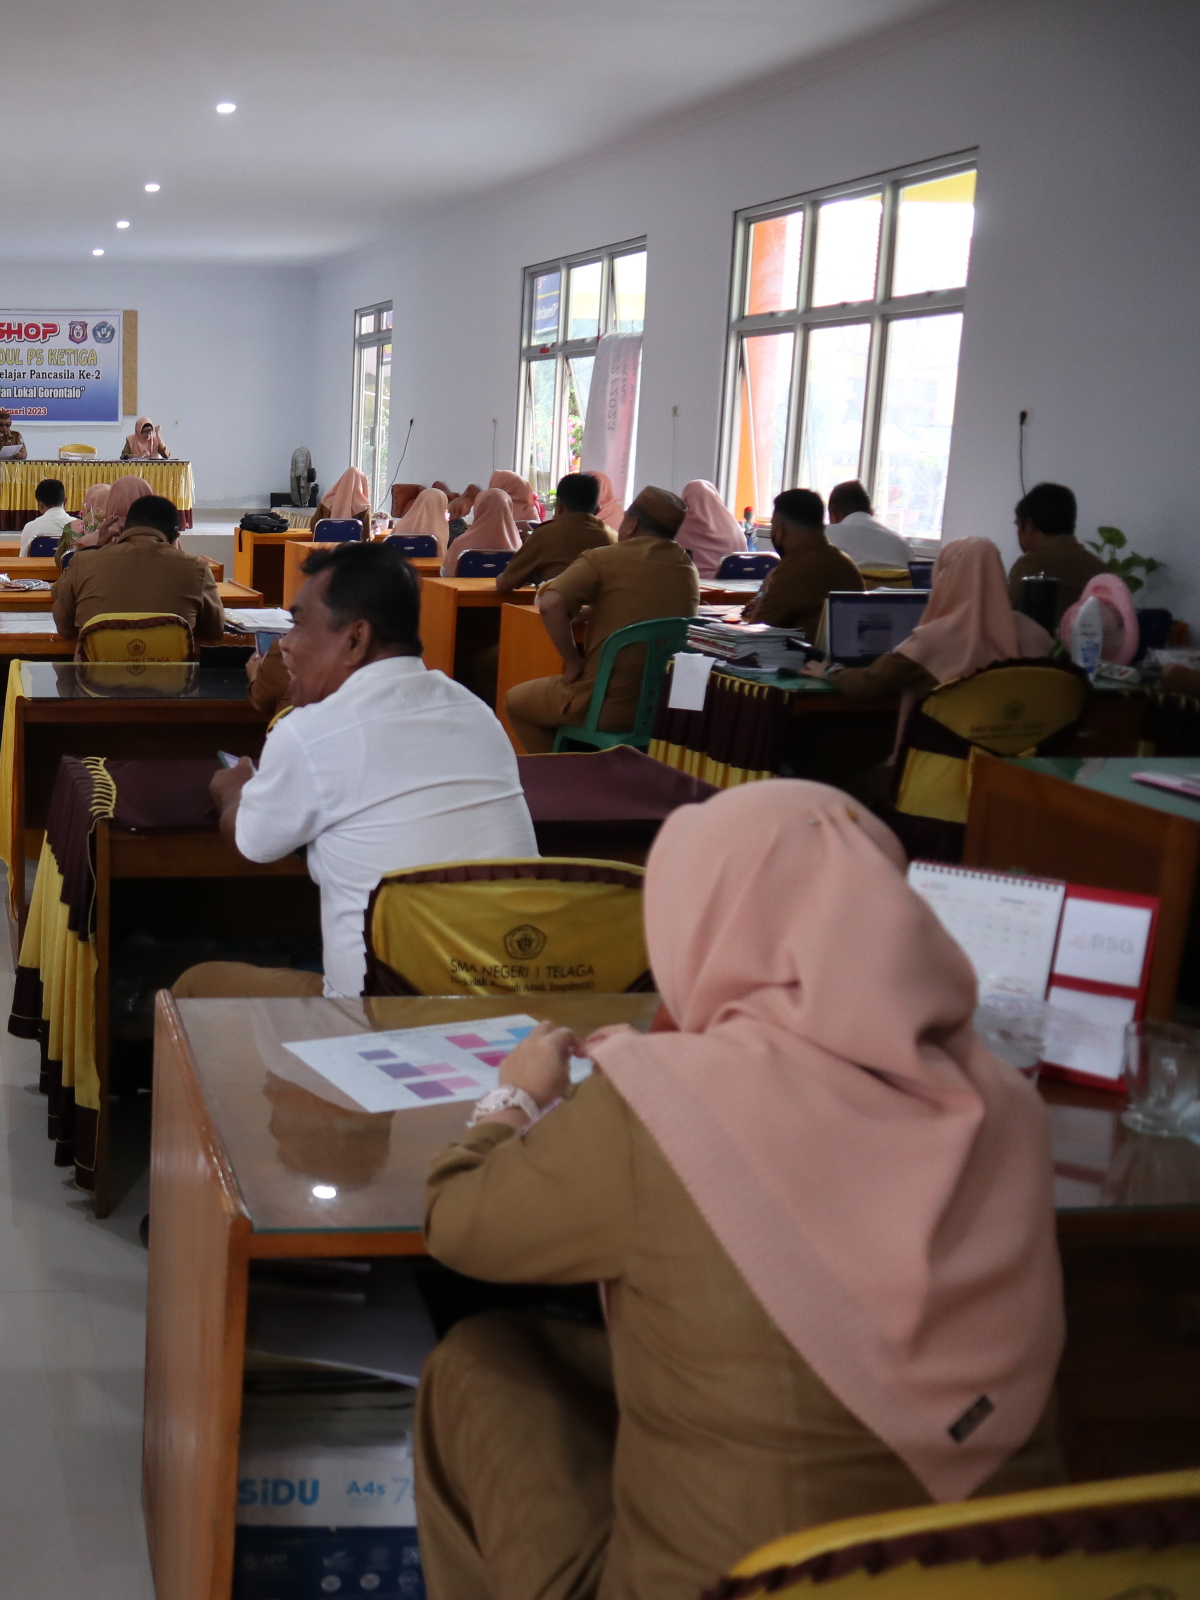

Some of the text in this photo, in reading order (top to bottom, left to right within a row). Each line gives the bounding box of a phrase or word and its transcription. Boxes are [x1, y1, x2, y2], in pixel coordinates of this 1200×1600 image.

[26, 348, 44, 366] P5
[47, 348, 98, 366] KETIGA
[29, 369, 75, 380] Pancasila
[78, 369, 101, 380] Ke-2
[13, 385, 37, 398] Lokal
[27, 407, 47, 415] 2023
[450, 959, 478, 973] SMA
[483, 964, 529, 979] NEGERI
[546, 964, 595, 979] TELAGA
[237, 1478, 320, 1507] SiDU
[392, 1476, 415, 1505] 7
